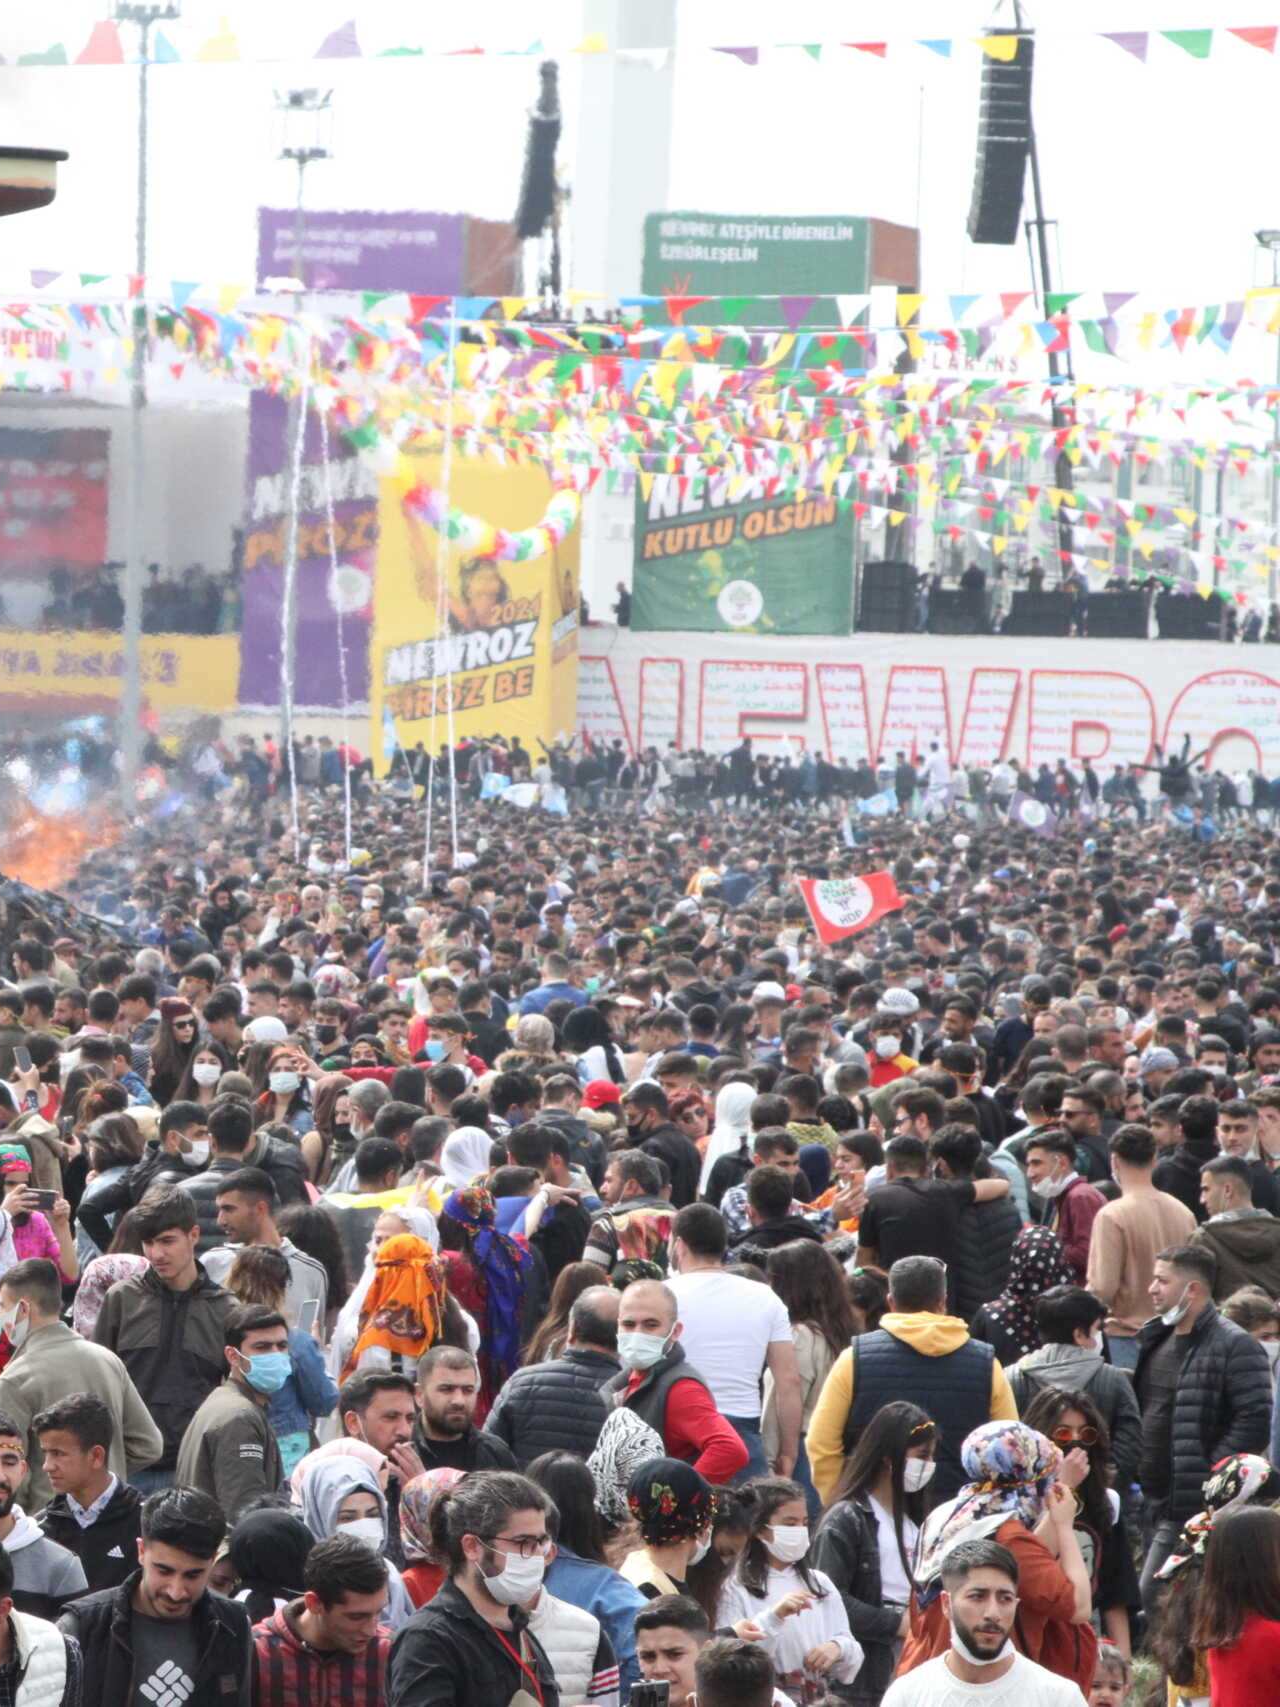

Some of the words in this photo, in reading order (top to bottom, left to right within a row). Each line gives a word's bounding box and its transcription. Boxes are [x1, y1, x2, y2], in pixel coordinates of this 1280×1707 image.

[643, 517, 735, 558] KUTLU
[743, 494, 837, 539] OLSUN
[386, 620, 538, 685] NEWROZ
[494, 665, 535, 702] BE
[839, 909, 863, 925] HDP
